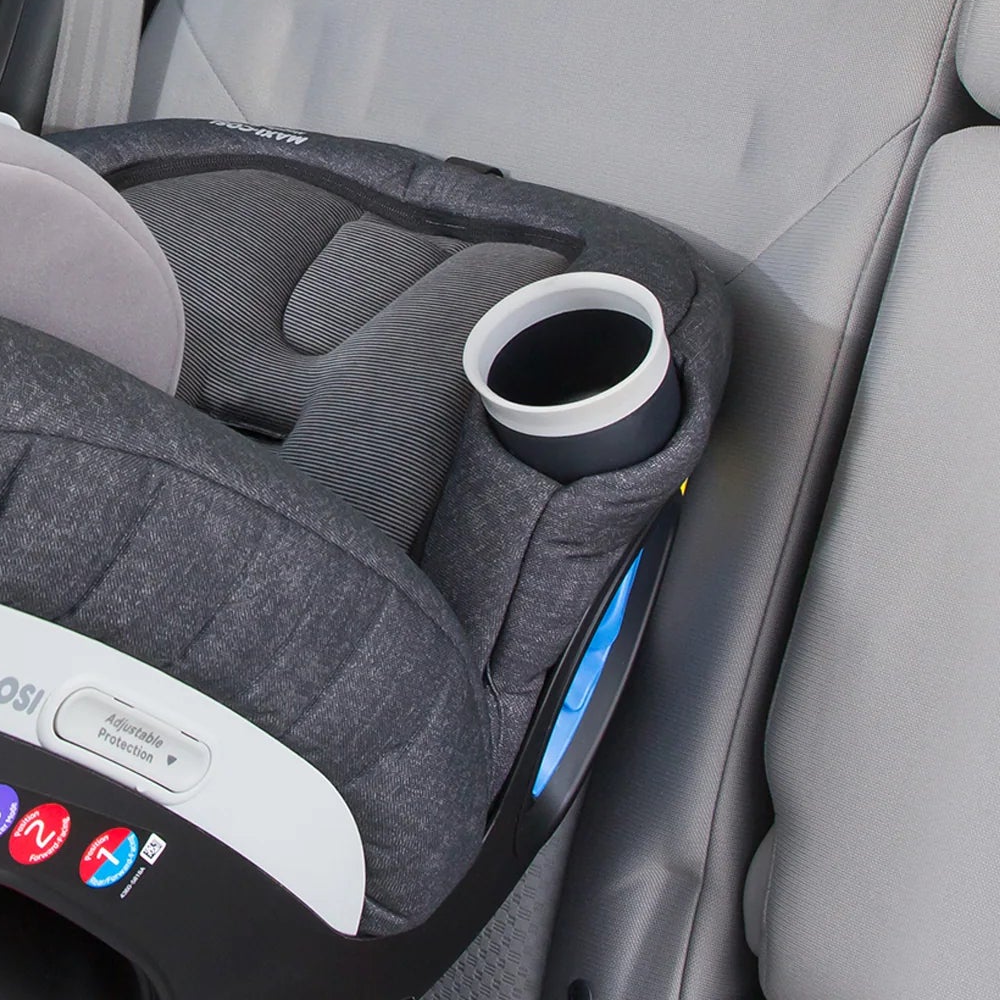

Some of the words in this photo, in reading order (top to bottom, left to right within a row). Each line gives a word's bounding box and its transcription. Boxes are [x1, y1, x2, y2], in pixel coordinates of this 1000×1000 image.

[104, 713, 165, 749] Adjustable
[96, 727, 155, 765] Protection
[14, 810, 40, 838] Position
[24, 819, 56, 849] 2
[84, 834, 110, 862] Position
[96, 847, 120, 866] 1
